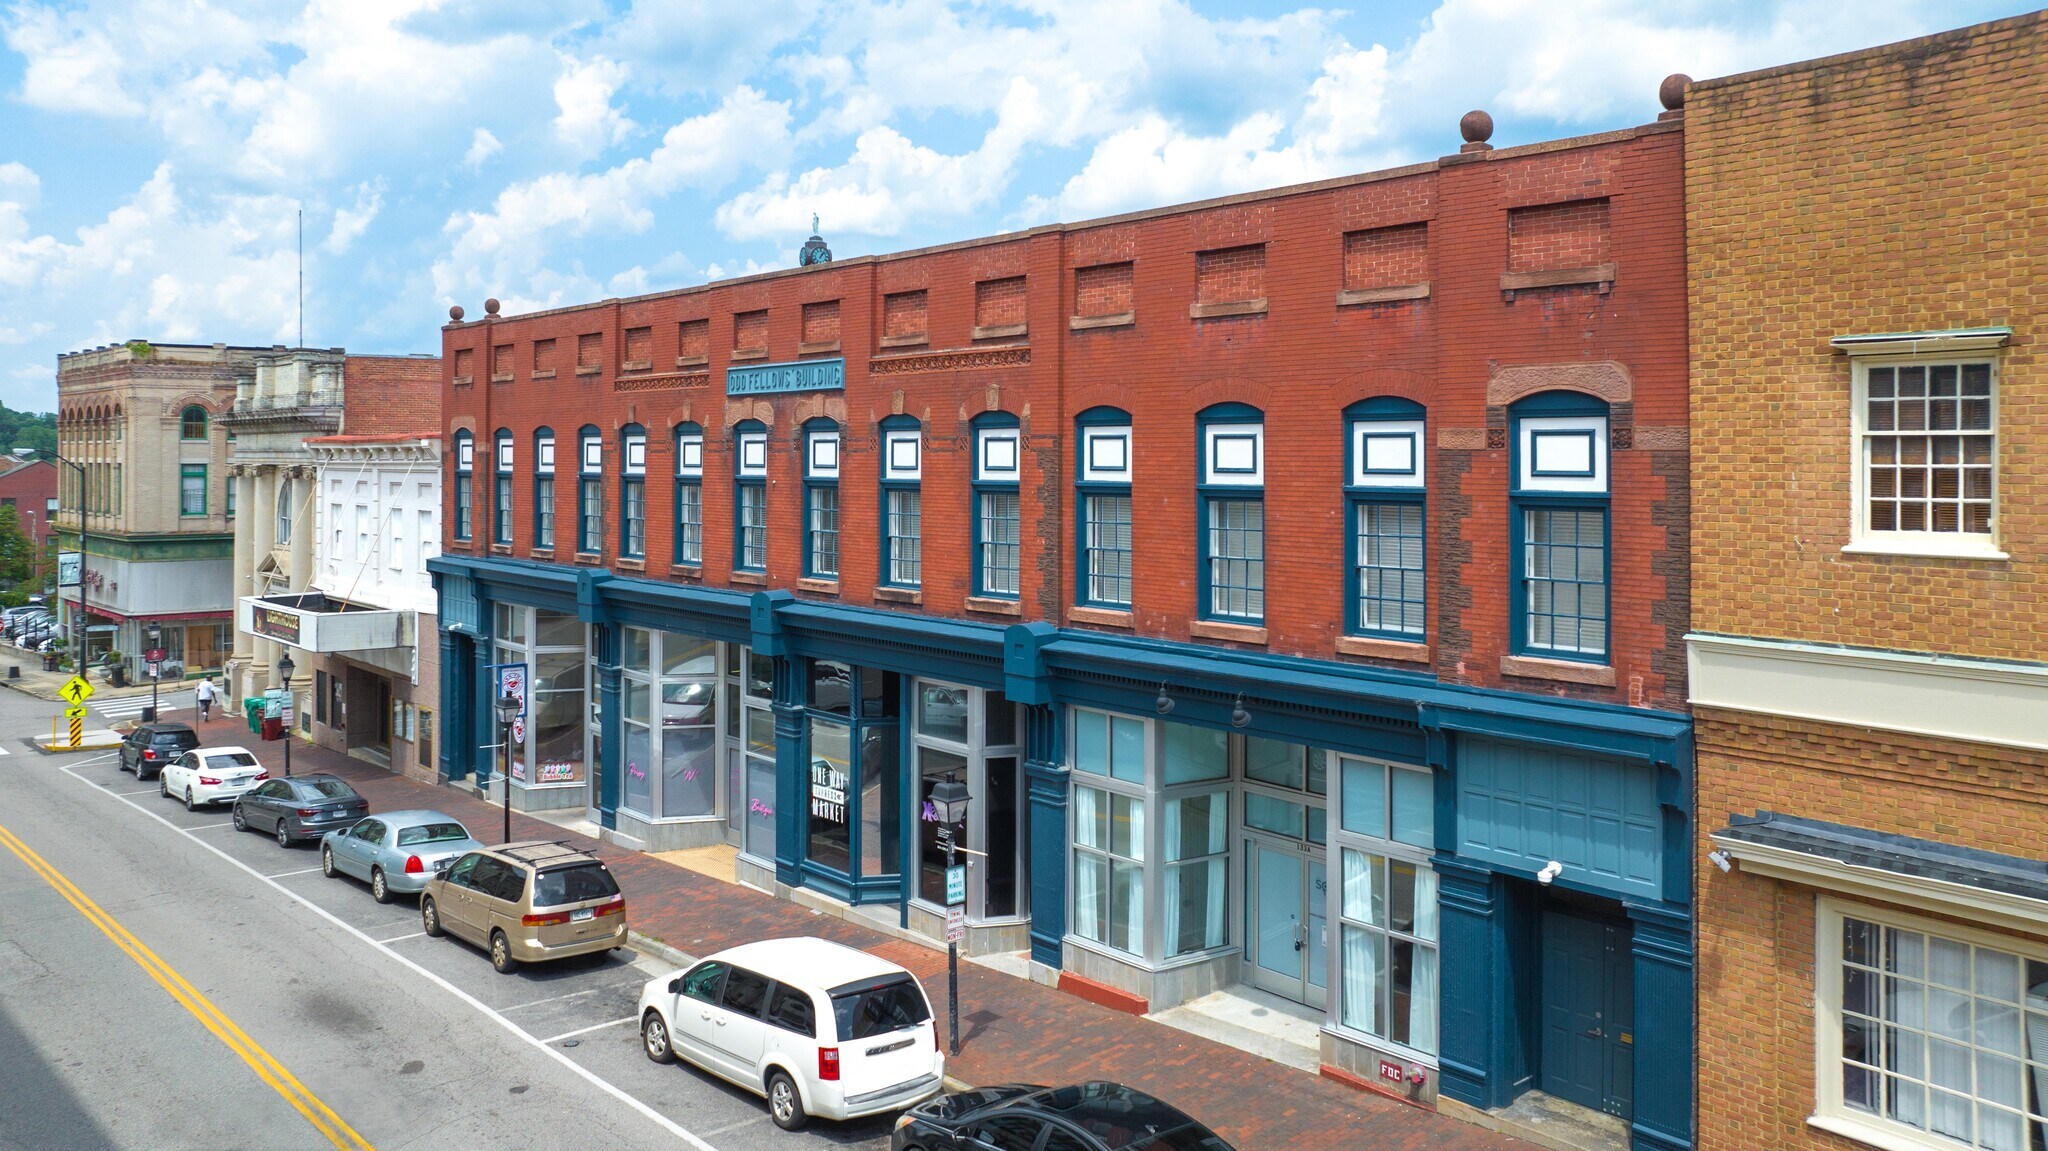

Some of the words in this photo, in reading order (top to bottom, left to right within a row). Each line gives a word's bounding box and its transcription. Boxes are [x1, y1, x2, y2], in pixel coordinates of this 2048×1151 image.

[730, 374, 747, 392] ODD
[796, 366, 841, 387] BUILDING
[812, 765, 827, 785] ONE
[829, 769, 845, 790] WAY
[812, 798, 845, 824] MARKET
[948, 890, 964, 899] PARKING
